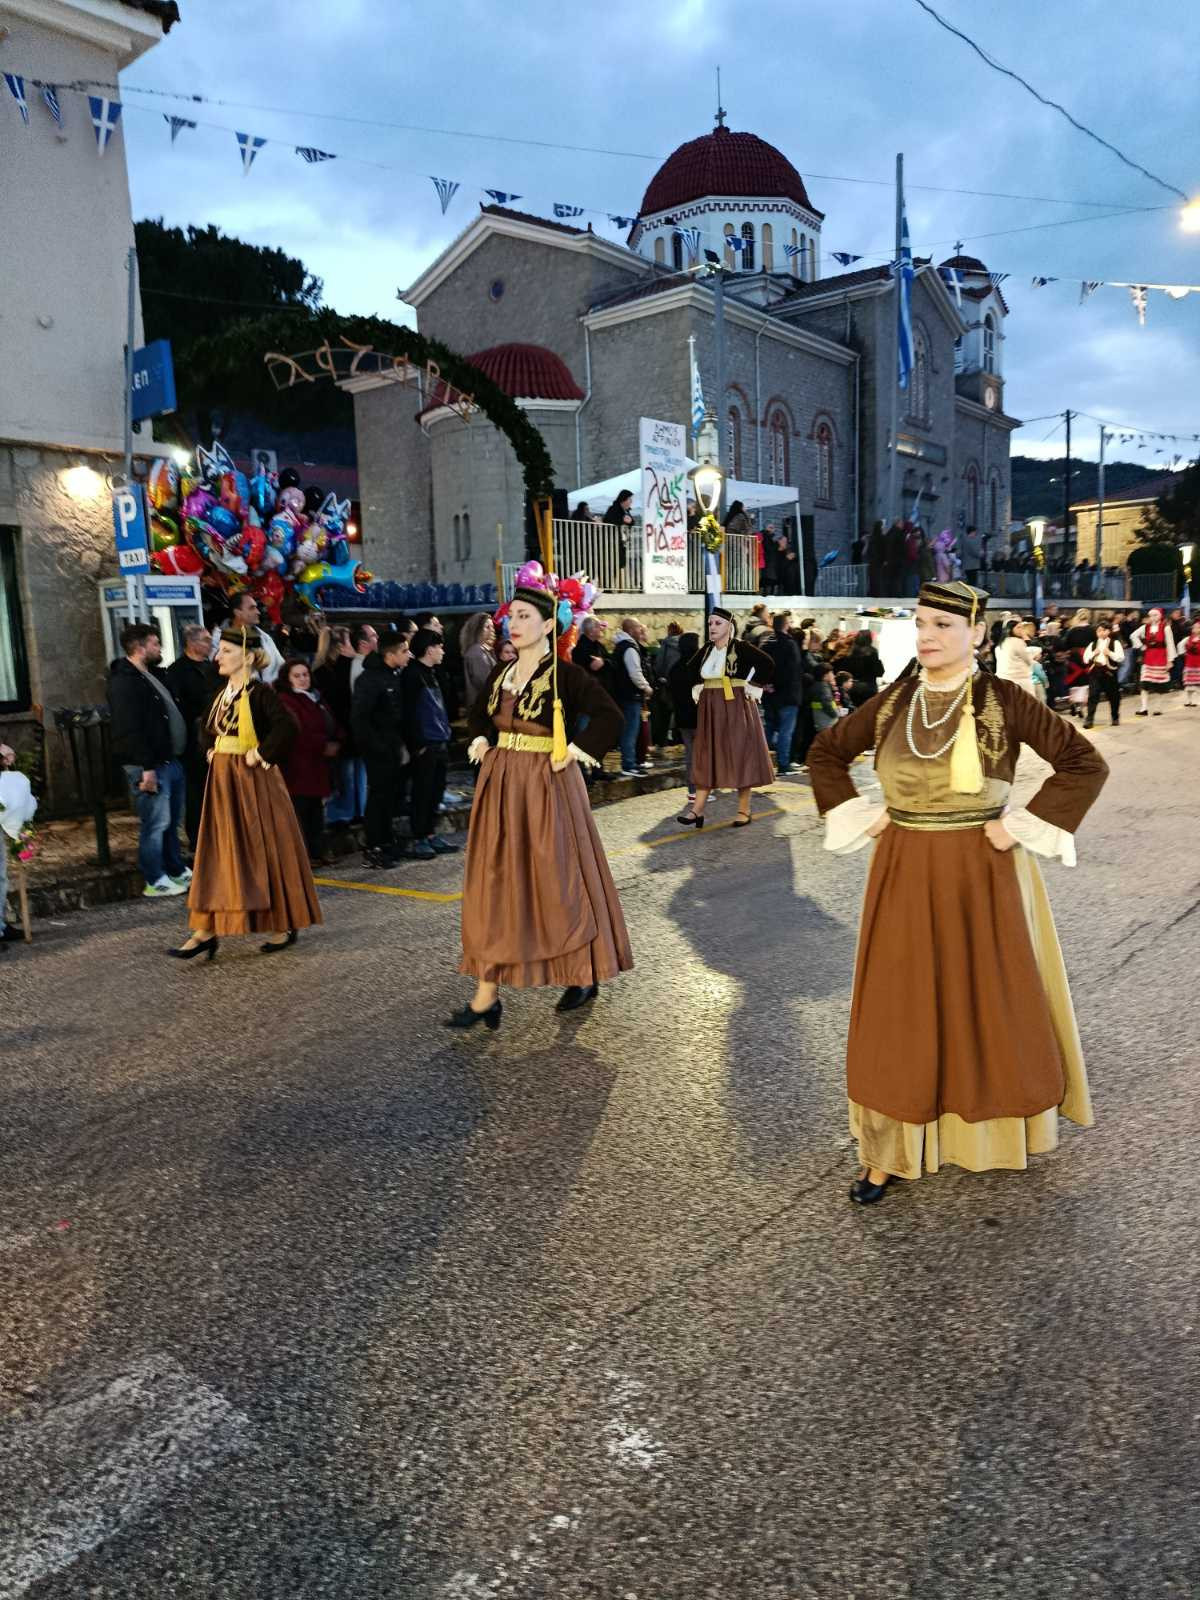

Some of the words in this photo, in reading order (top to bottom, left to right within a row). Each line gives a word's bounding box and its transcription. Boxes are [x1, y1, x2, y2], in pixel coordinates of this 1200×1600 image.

[131, 369, 149, 391] ΕΠ
[119, 494, 137, 538] P
[124, 552, 143, 565] TAXI
